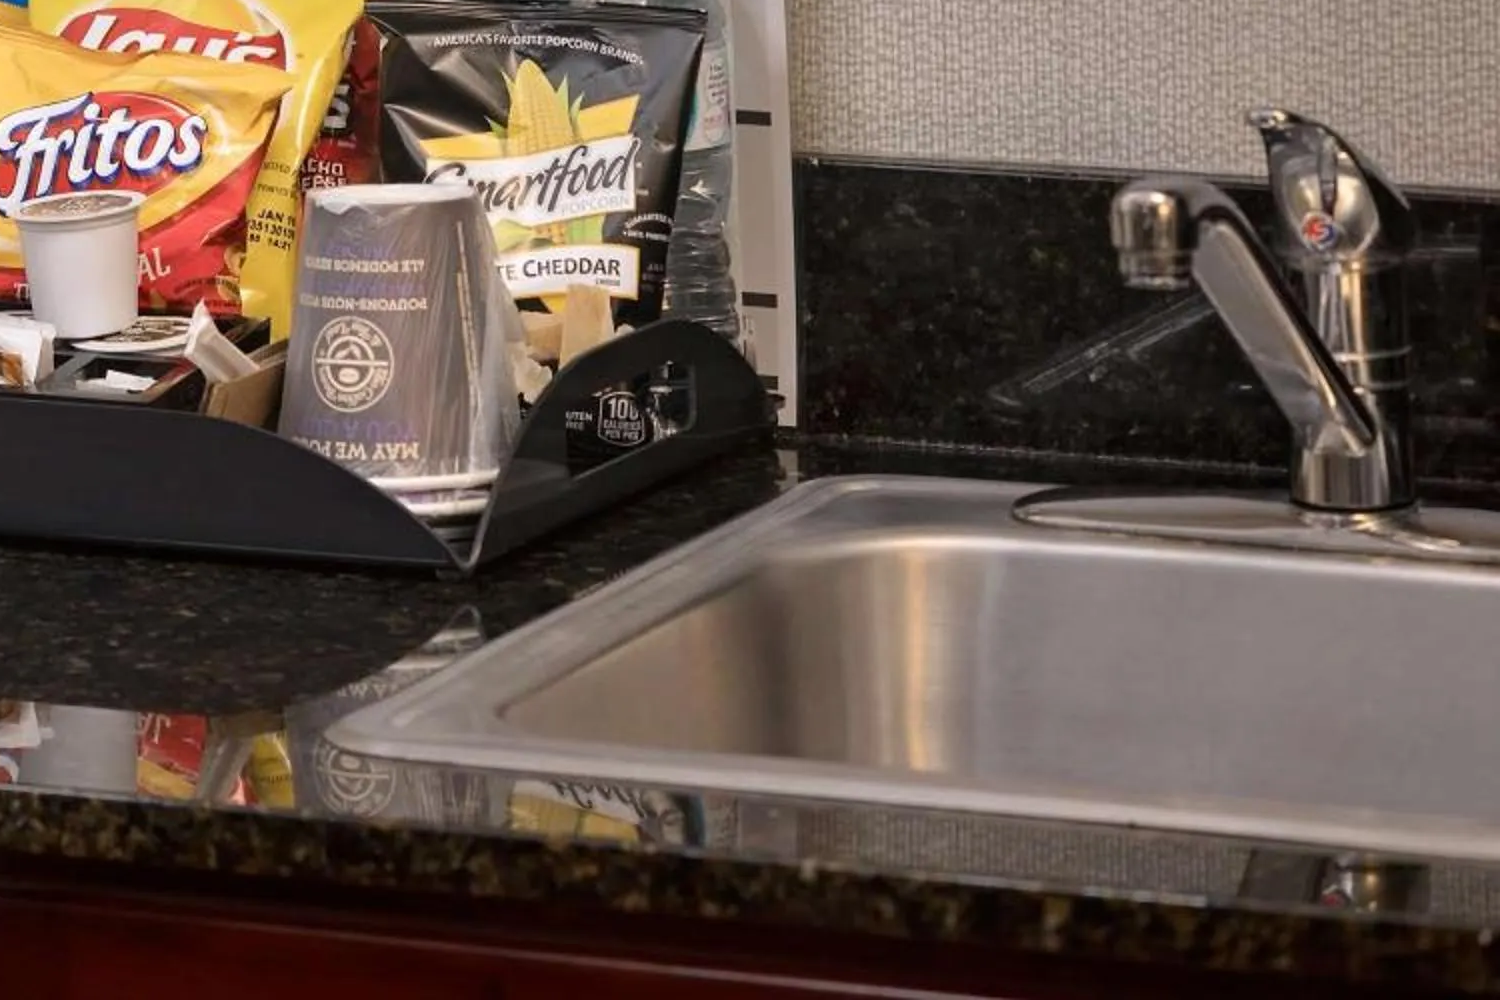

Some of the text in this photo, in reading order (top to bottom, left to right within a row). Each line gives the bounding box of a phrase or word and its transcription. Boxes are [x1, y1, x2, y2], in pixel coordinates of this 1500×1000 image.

[433, 34, 493, 48] AMERICA'S
[493, 34, 544, 46] FAVORITE
[545, 35, 599, 53] POPCORN
[522, 258, 621, 278] CHEDDAR
[608, 397, 639, 421] 100
[334, 441, 367, 461] WE
[372, 441, 421, 461] MAY
